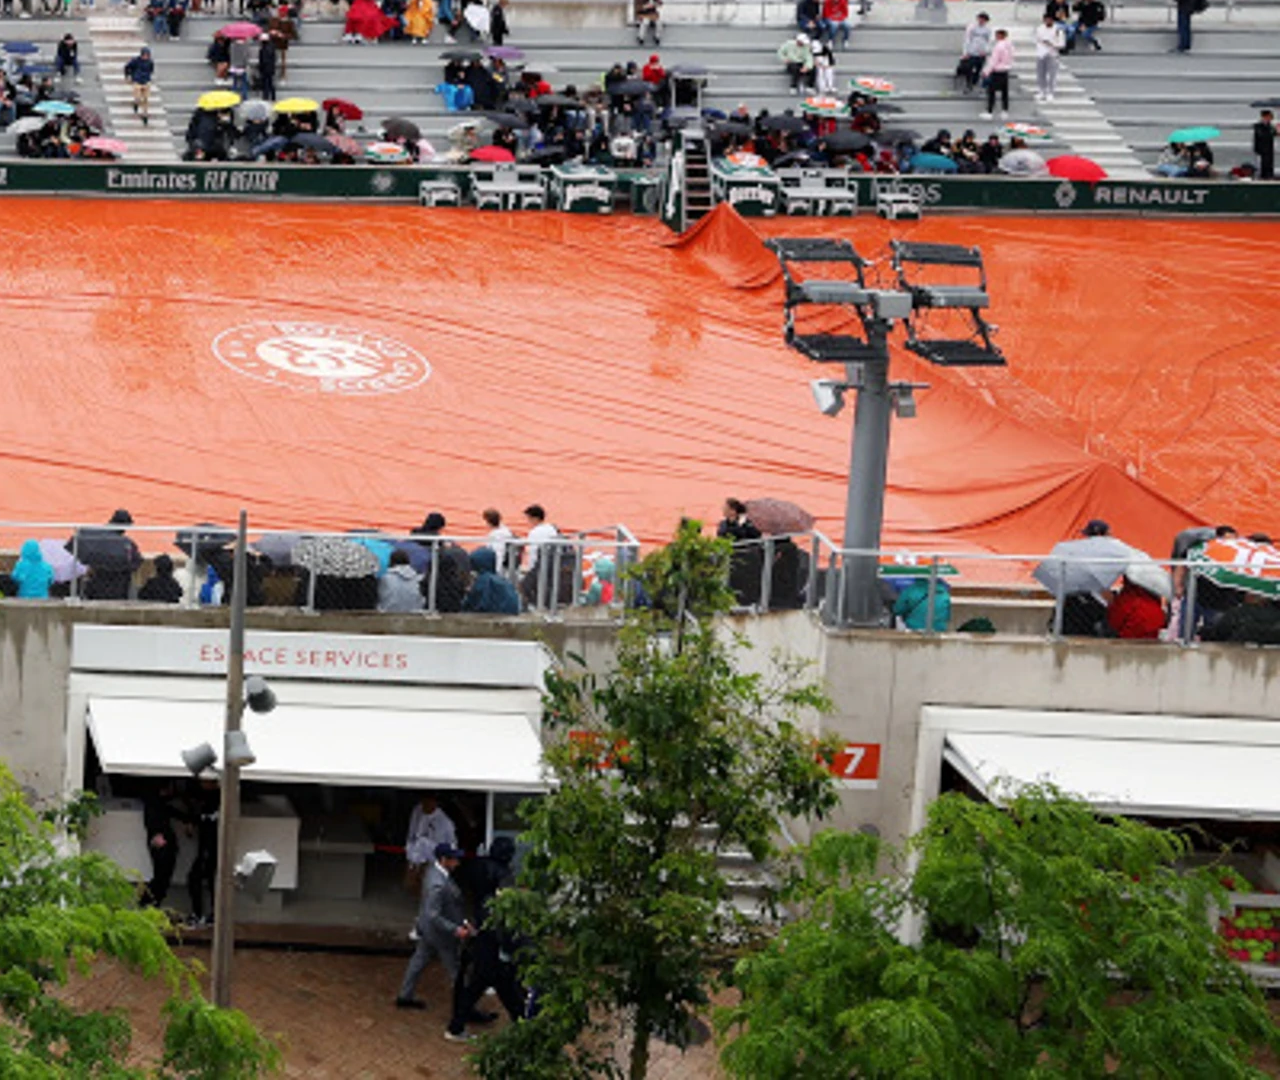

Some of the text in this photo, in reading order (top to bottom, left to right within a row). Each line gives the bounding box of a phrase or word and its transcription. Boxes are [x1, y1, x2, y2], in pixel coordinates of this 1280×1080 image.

[106, 169, 196, 189] Emirates
[1095, 186, 1209, 204] RENAULT
[199, 644, 408, 670] ESACE SERVICES
[844, 747, 866, 775] 7
